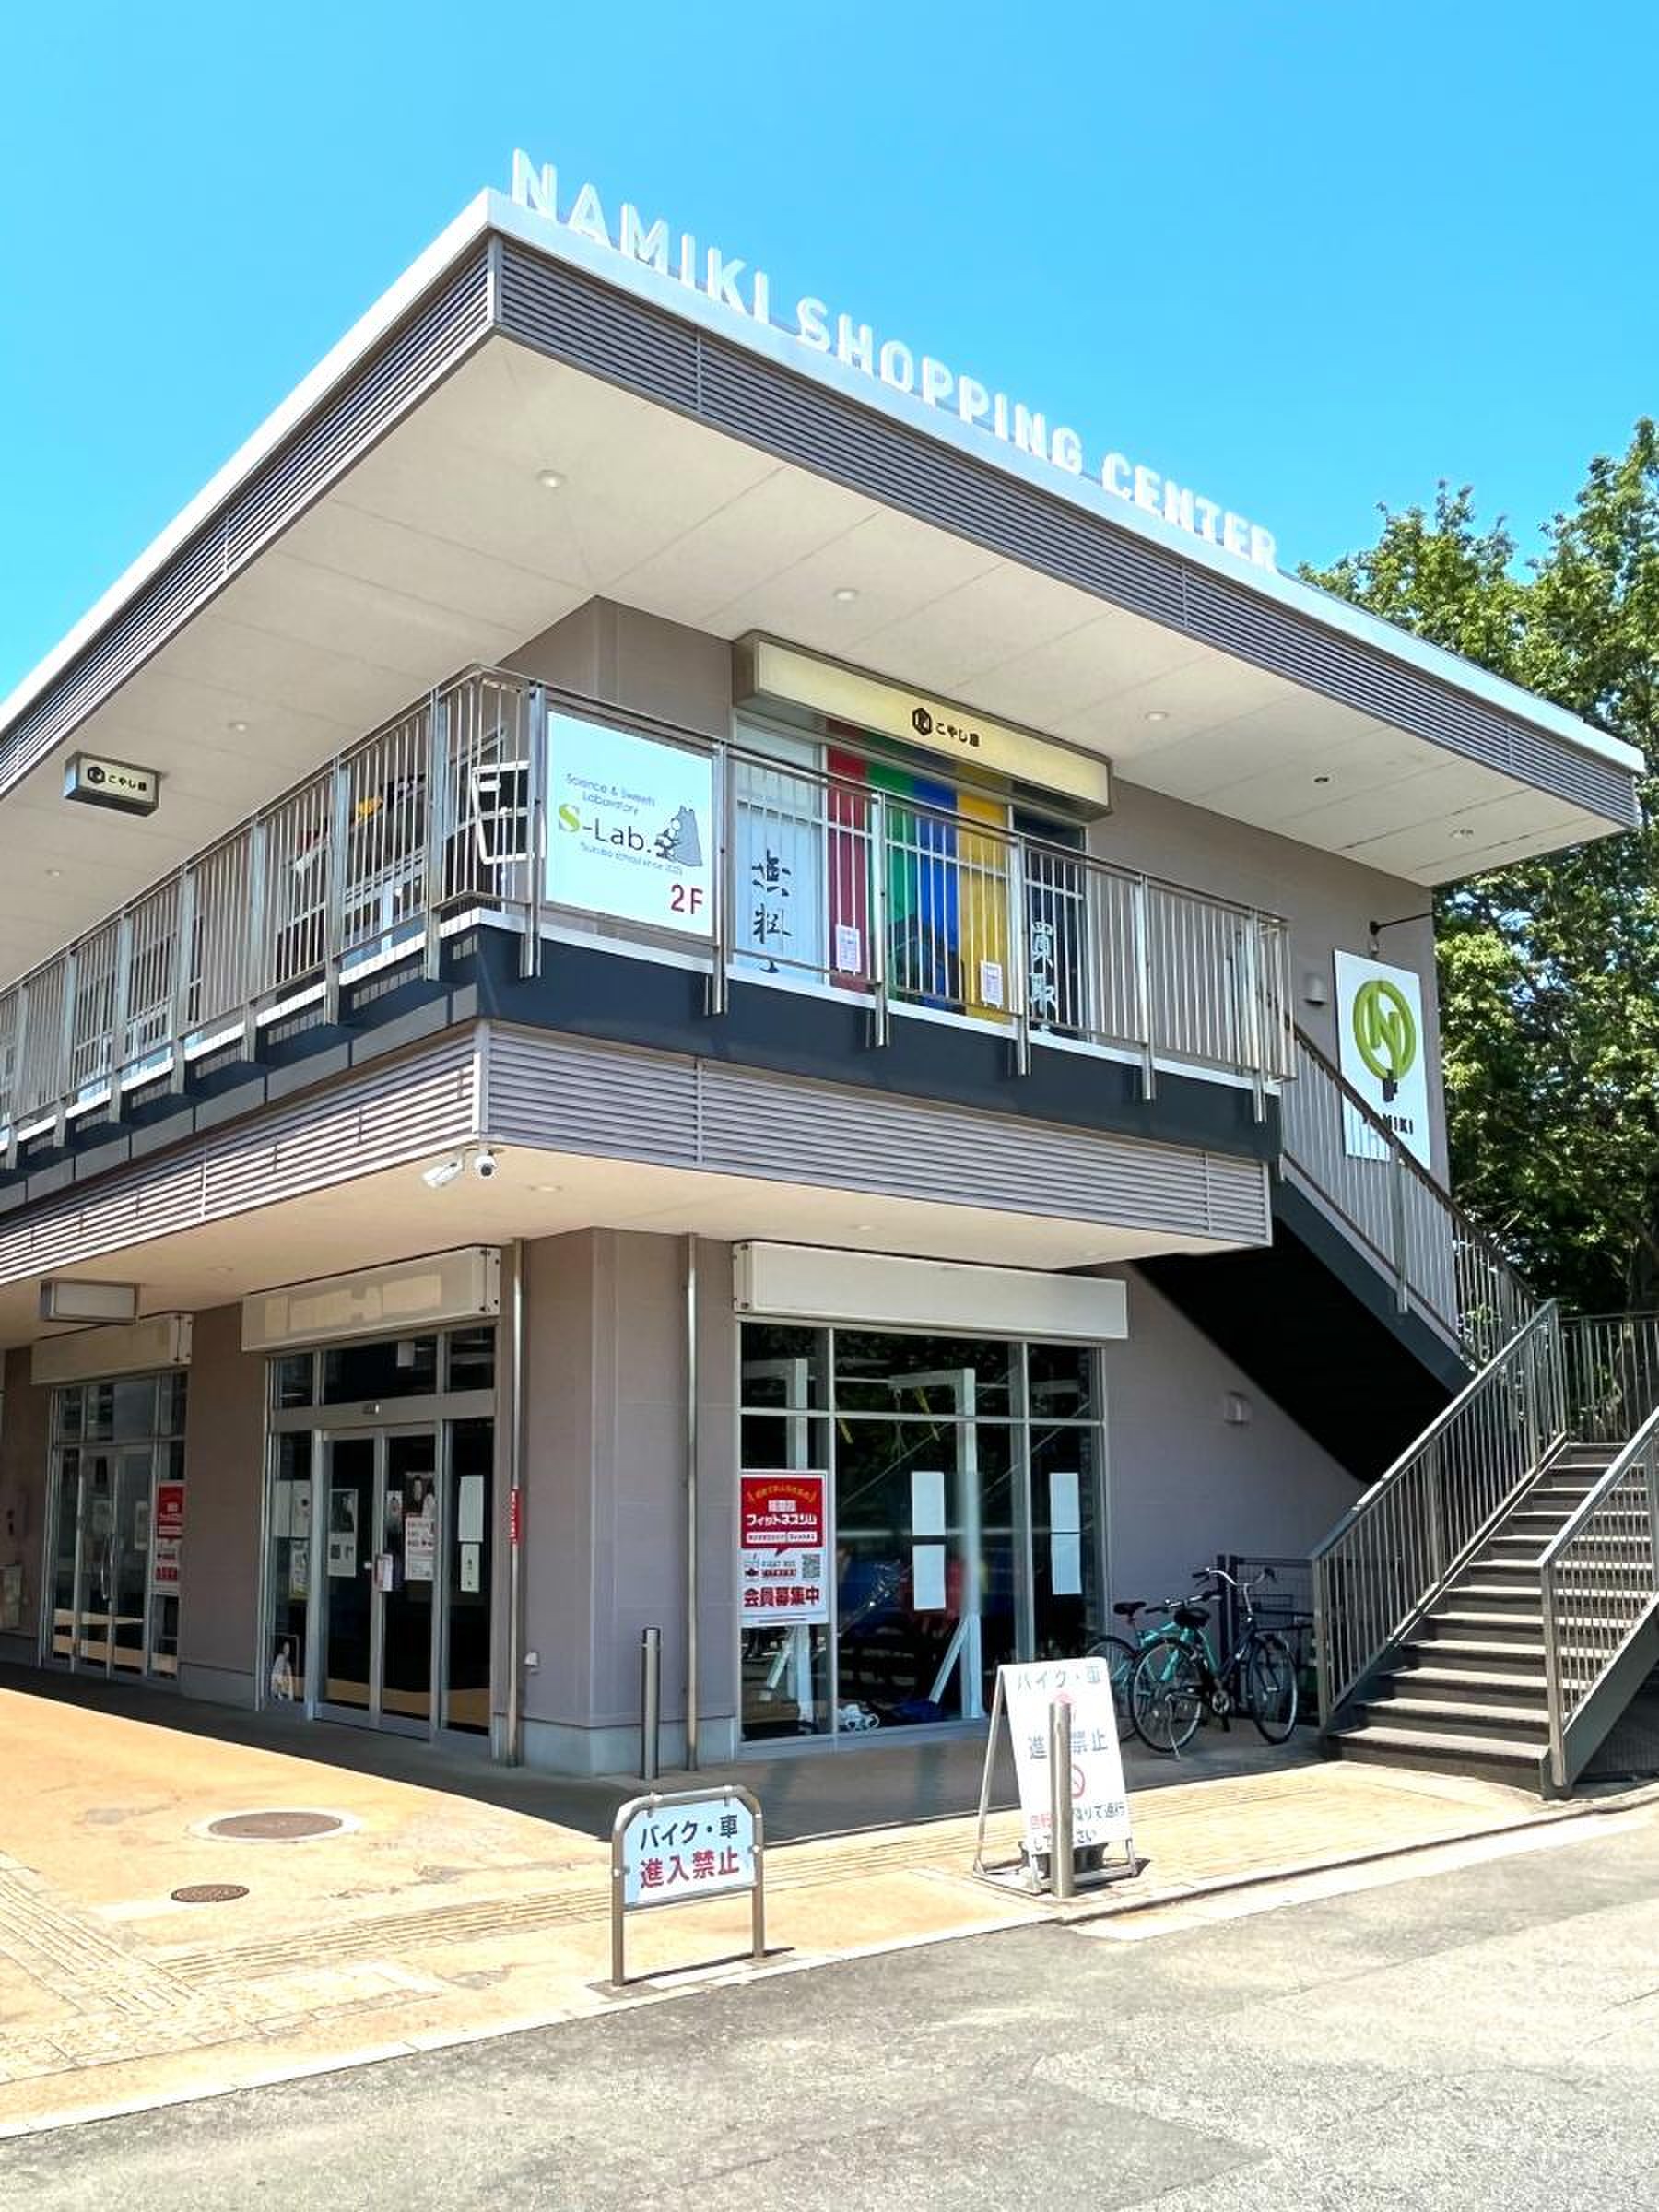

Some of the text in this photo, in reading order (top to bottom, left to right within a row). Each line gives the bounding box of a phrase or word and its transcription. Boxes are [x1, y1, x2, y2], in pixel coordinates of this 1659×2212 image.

[512, 147, 1279, 575] NAMIKI SHOPPING CENTER
[669, 882, 704, 915] 2F
[744, 1585, 820, 1607] 会員募集中
[1027, 1726, 1109, 1760] 進禁止
[640, 1813, 739, 1851] バイク・車
[640, 1845, 740, 1889] 進入禁止
